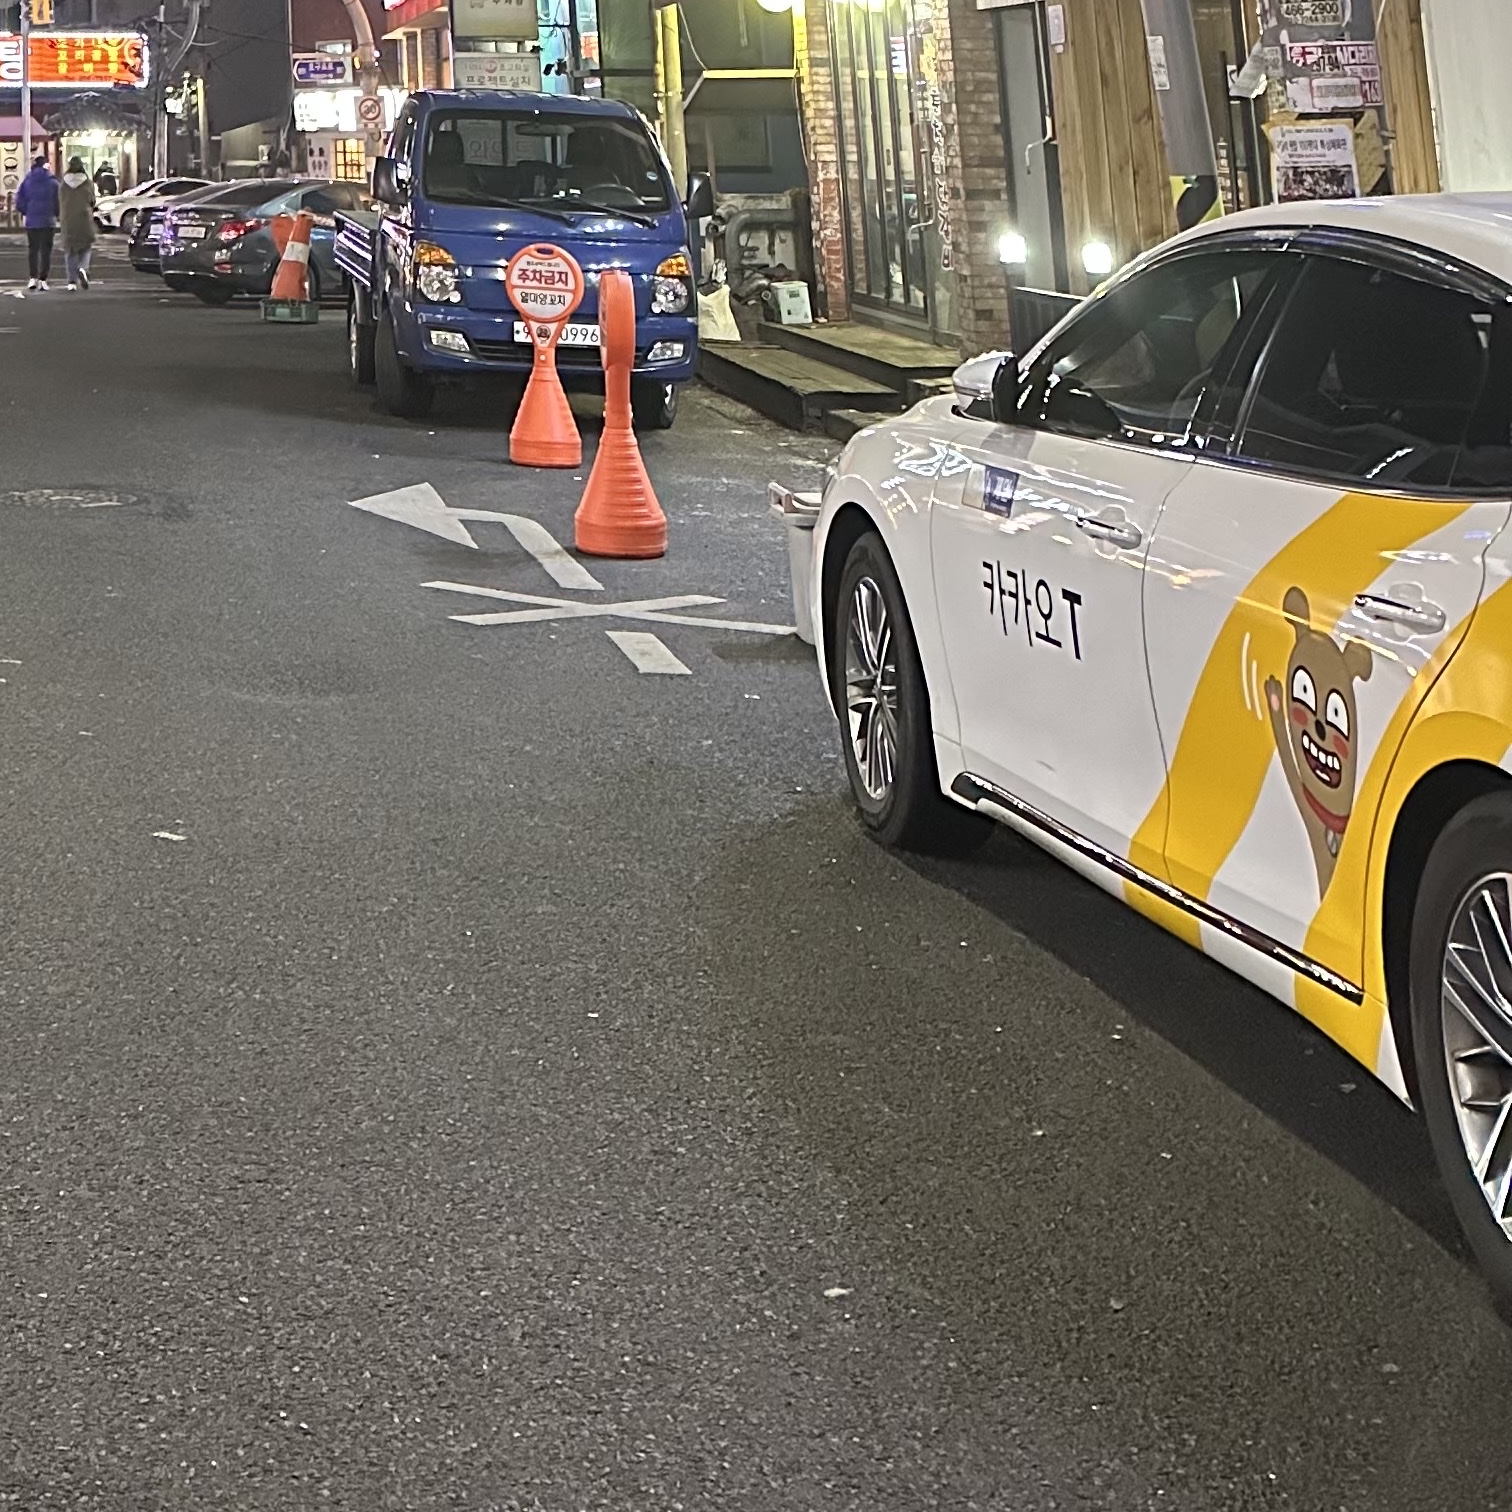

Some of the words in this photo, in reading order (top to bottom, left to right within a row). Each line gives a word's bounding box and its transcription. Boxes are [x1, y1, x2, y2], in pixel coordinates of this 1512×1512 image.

[466, 75, 531, 88] 프로젝트설치
[518, 268, 568, 287] 주차금지
[982, 559, 1082, 661] 카카오T
